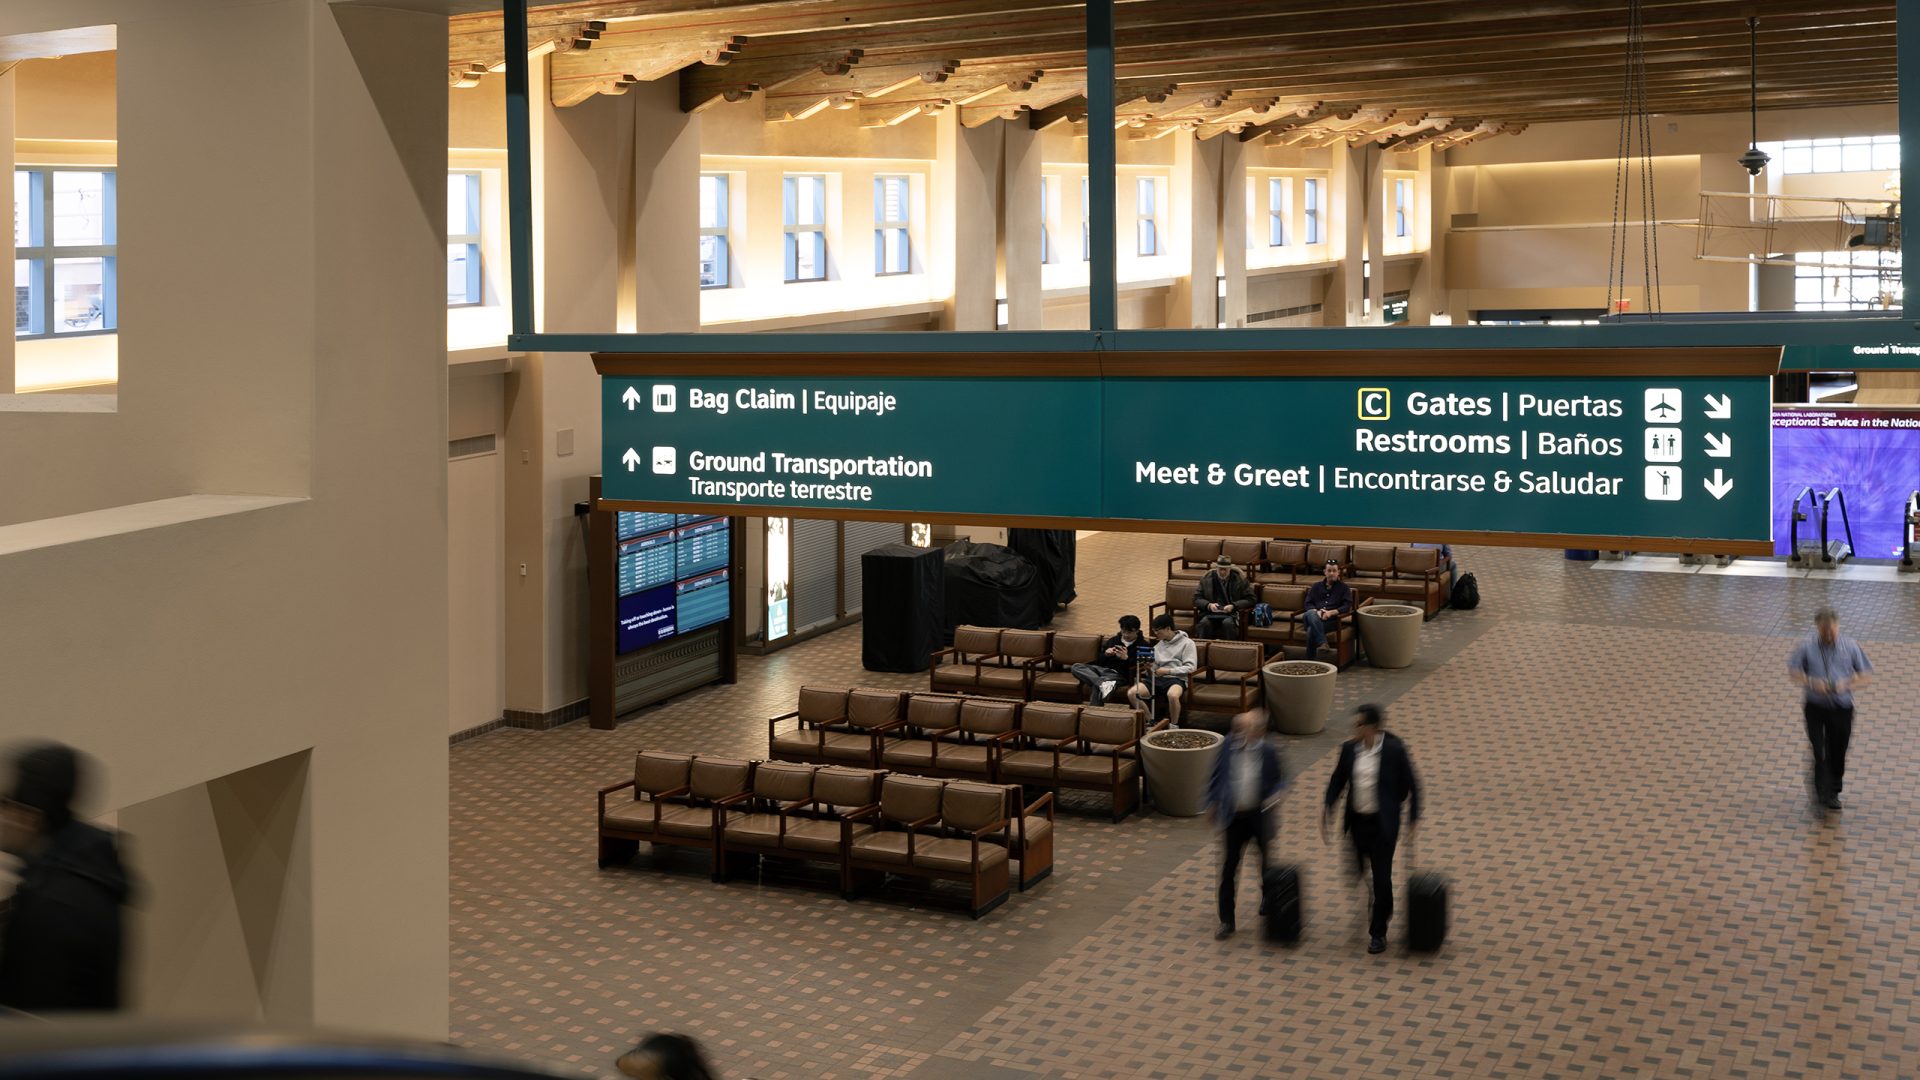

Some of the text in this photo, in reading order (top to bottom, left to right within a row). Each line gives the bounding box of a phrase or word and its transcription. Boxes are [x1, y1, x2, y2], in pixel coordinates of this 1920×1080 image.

[1853, 345, 1889, 355] Ground
[689, 388, 729, 415] Bag
[735, 387, 796, 410] Claim
[814, 390, 897, 416] Equipaje
[1365, 392, 1383, 415] C
[1406, 391, 1492, 416] Gates
[1519, 393, 1623, 417] Puertas
[1821, 417, 1859, 427] Service
[1860, 417, 1871, 427] in
[1872, 418, 1890, 428] the
[1890, 418, 1920, 428] Natio
[1356, 428, 1511, 454] Restrooms
[1538, 432, 1623, 456] Baños
[689, 450, 933, 481] Ground Transportation
[1135, 461, 1199, 485] Meet
[1207, 462, 1227, 486] &
[1233, 463, 1310, 488] Greet
[1334, 467, 1486, 492] Encontrarse
[1493, 470, 1513, 493] &
[1518, 470, 1624, 496] Saludar
[688, 476, 873, 502] Transporte terrestre
